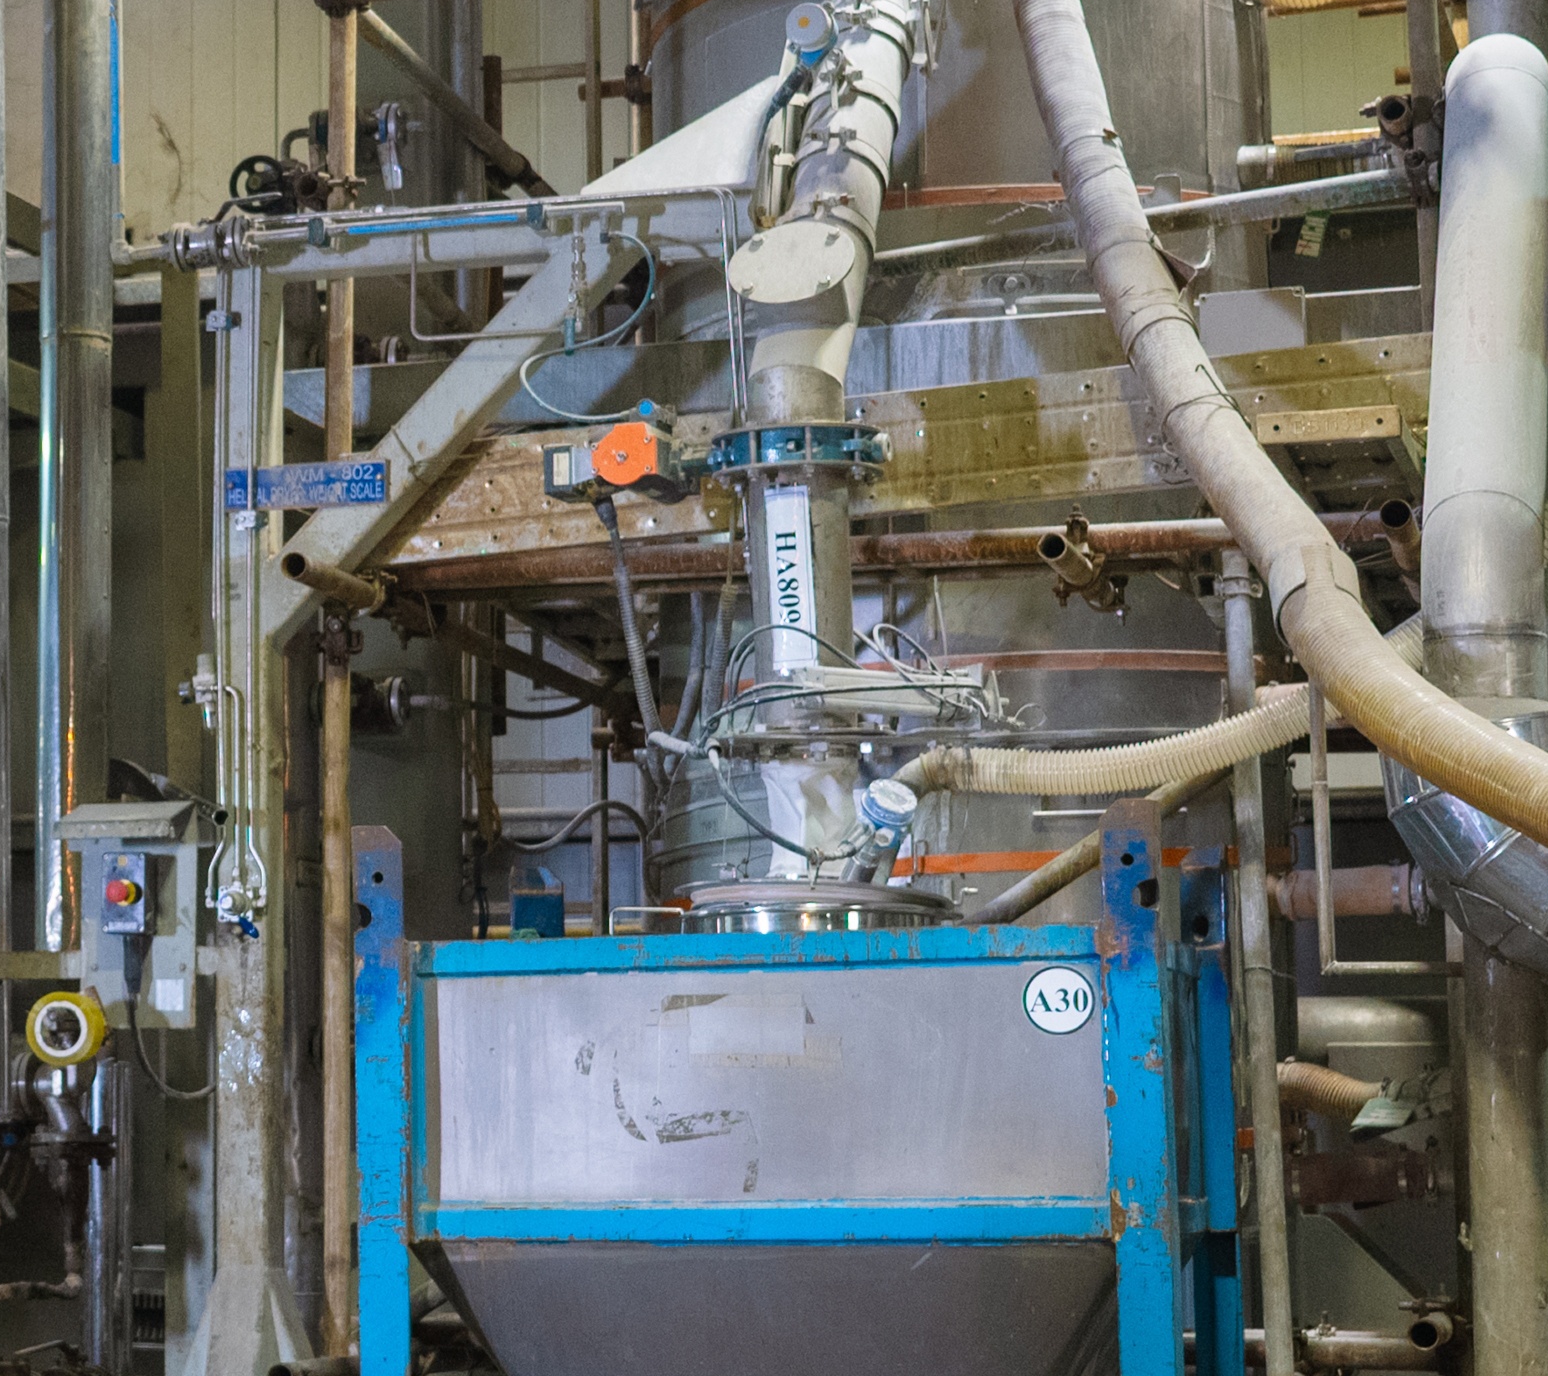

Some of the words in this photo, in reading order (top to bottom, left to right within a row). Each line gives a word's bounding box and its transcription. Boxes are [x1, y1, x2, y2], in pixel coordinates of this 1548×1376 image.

[342, 464, 374, 481] 802
[349, 481, 383, 500] SCALE
[775, 531, 801, 623] HA809
[1030, 987, 1089, 1013] A30
